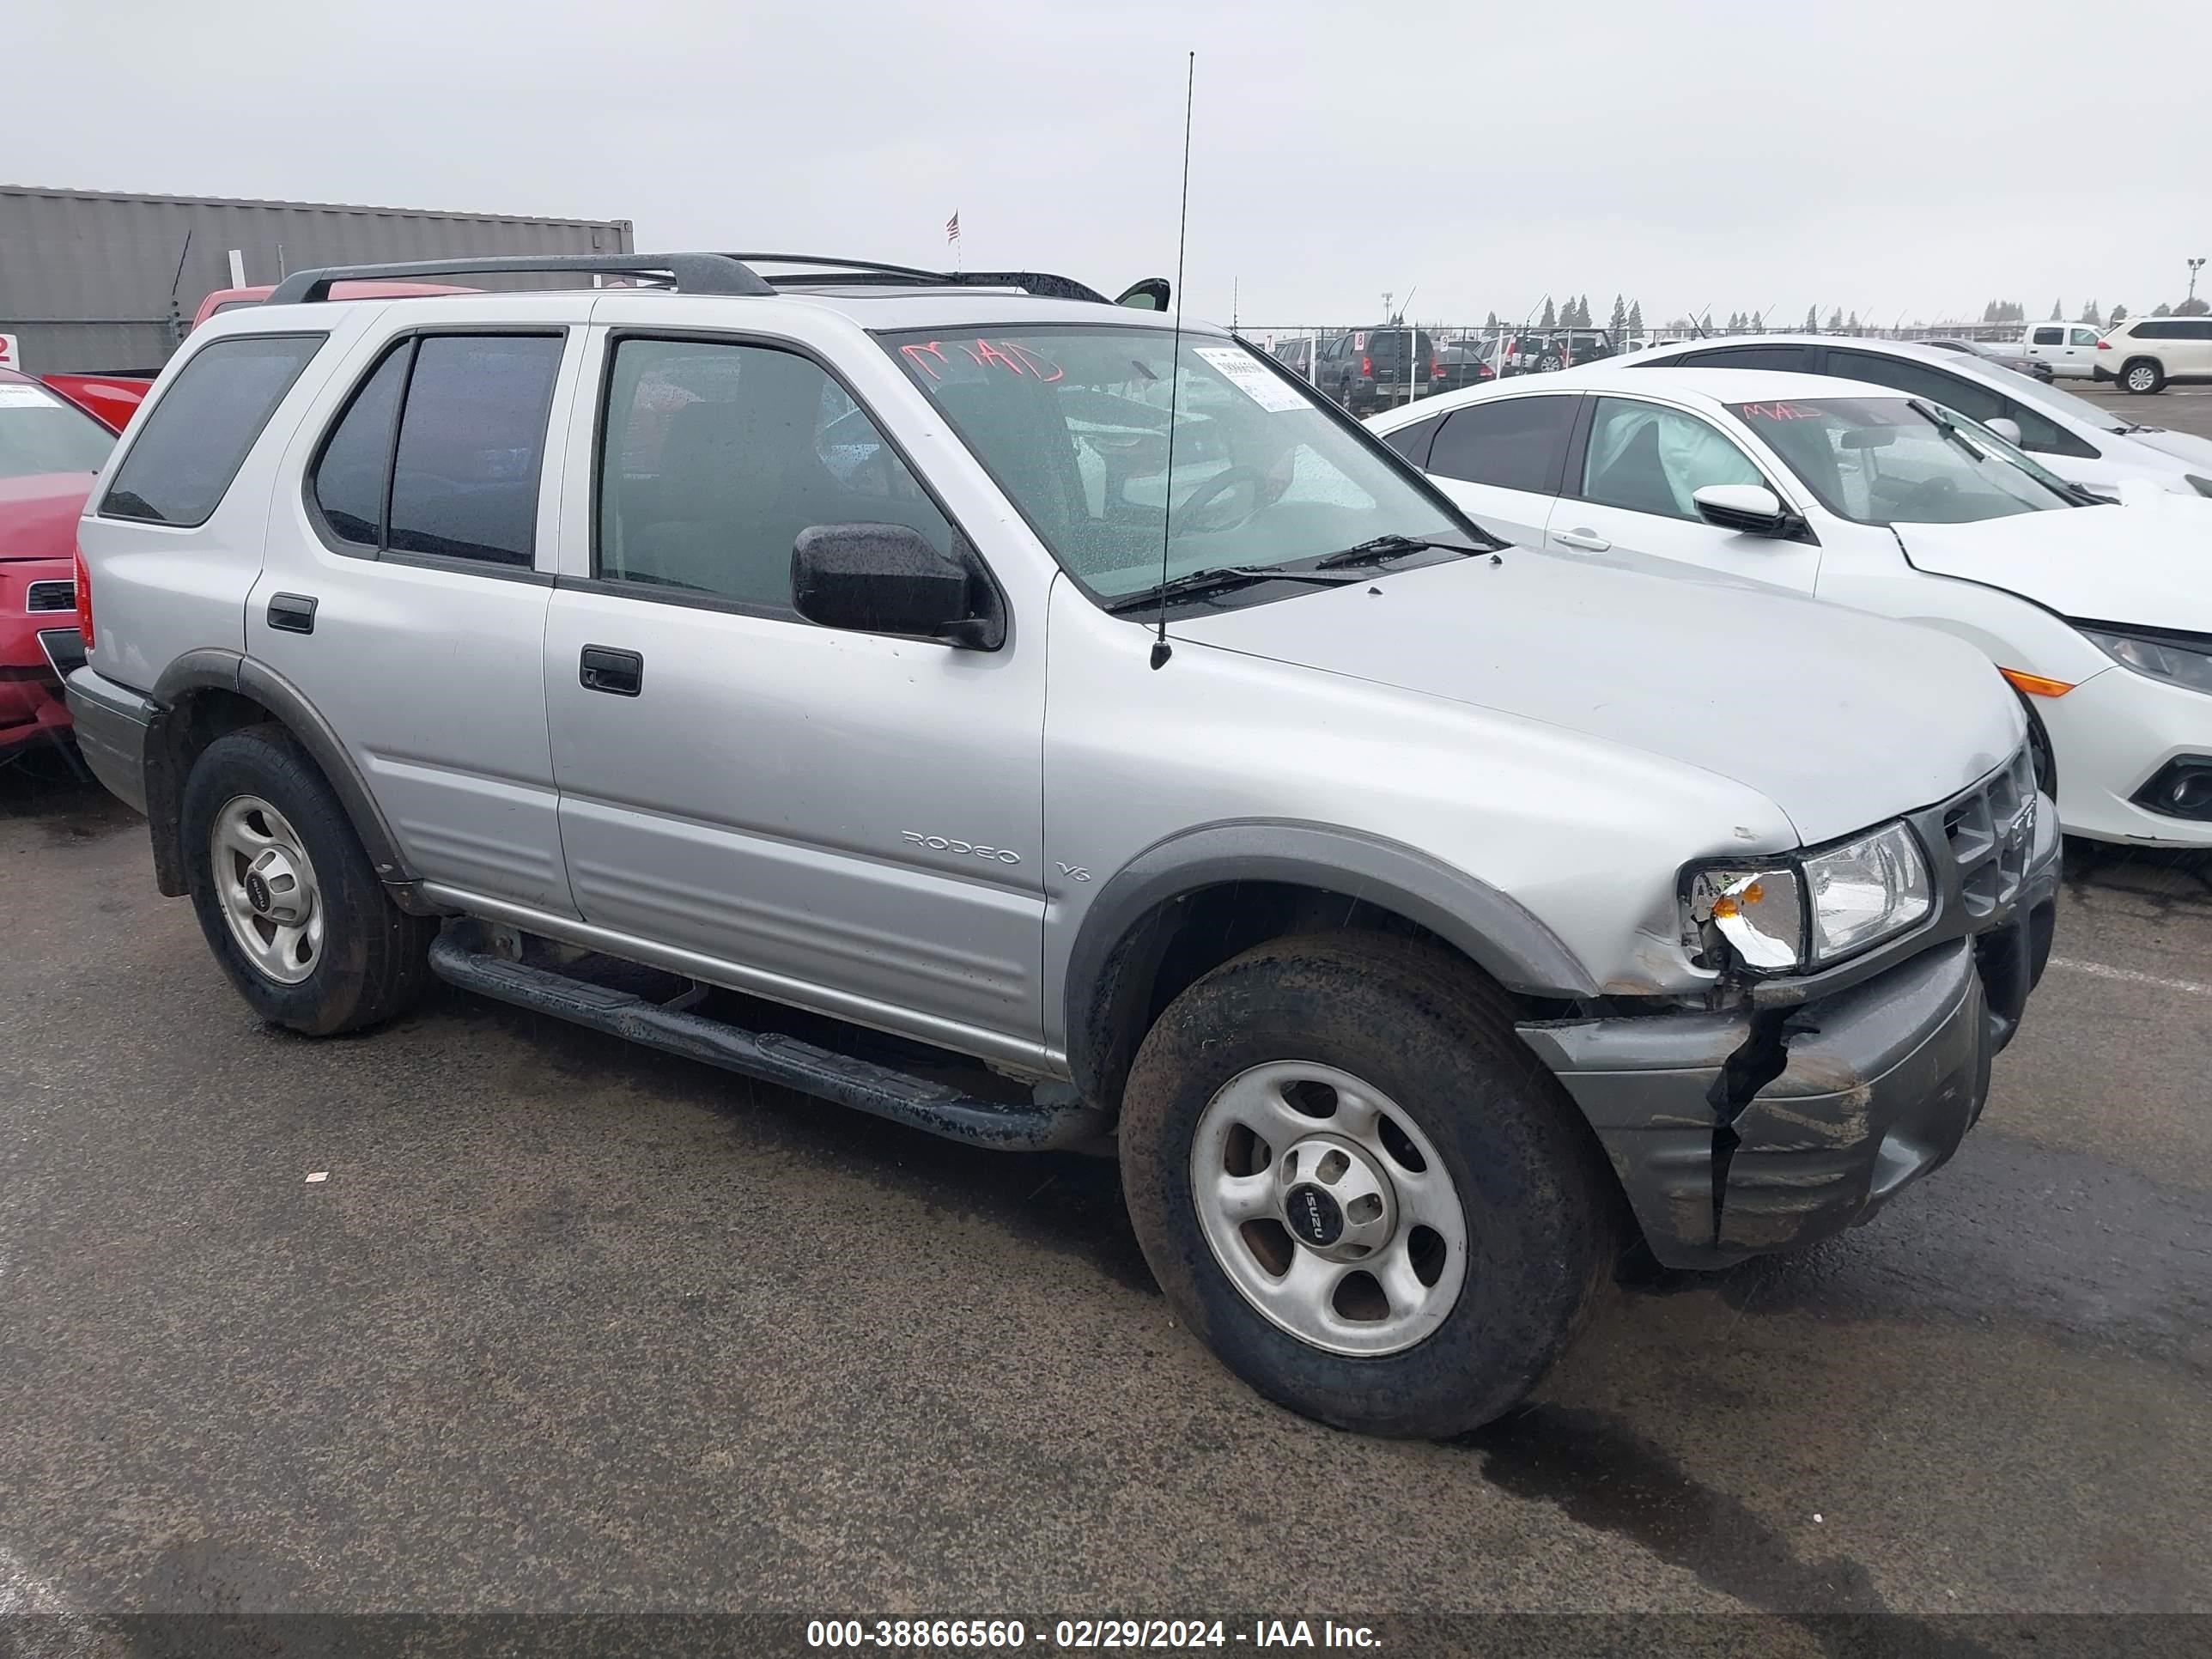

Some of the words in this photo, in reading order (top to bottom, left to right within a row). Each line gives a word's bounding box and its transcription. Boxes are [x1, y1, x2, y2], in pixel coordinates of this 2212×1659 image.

[901, 830, 1022, 865] RODEO
[1055, 860, 1092, 882] V6
[1304, 1192, 1323, 1239] ISUZU
